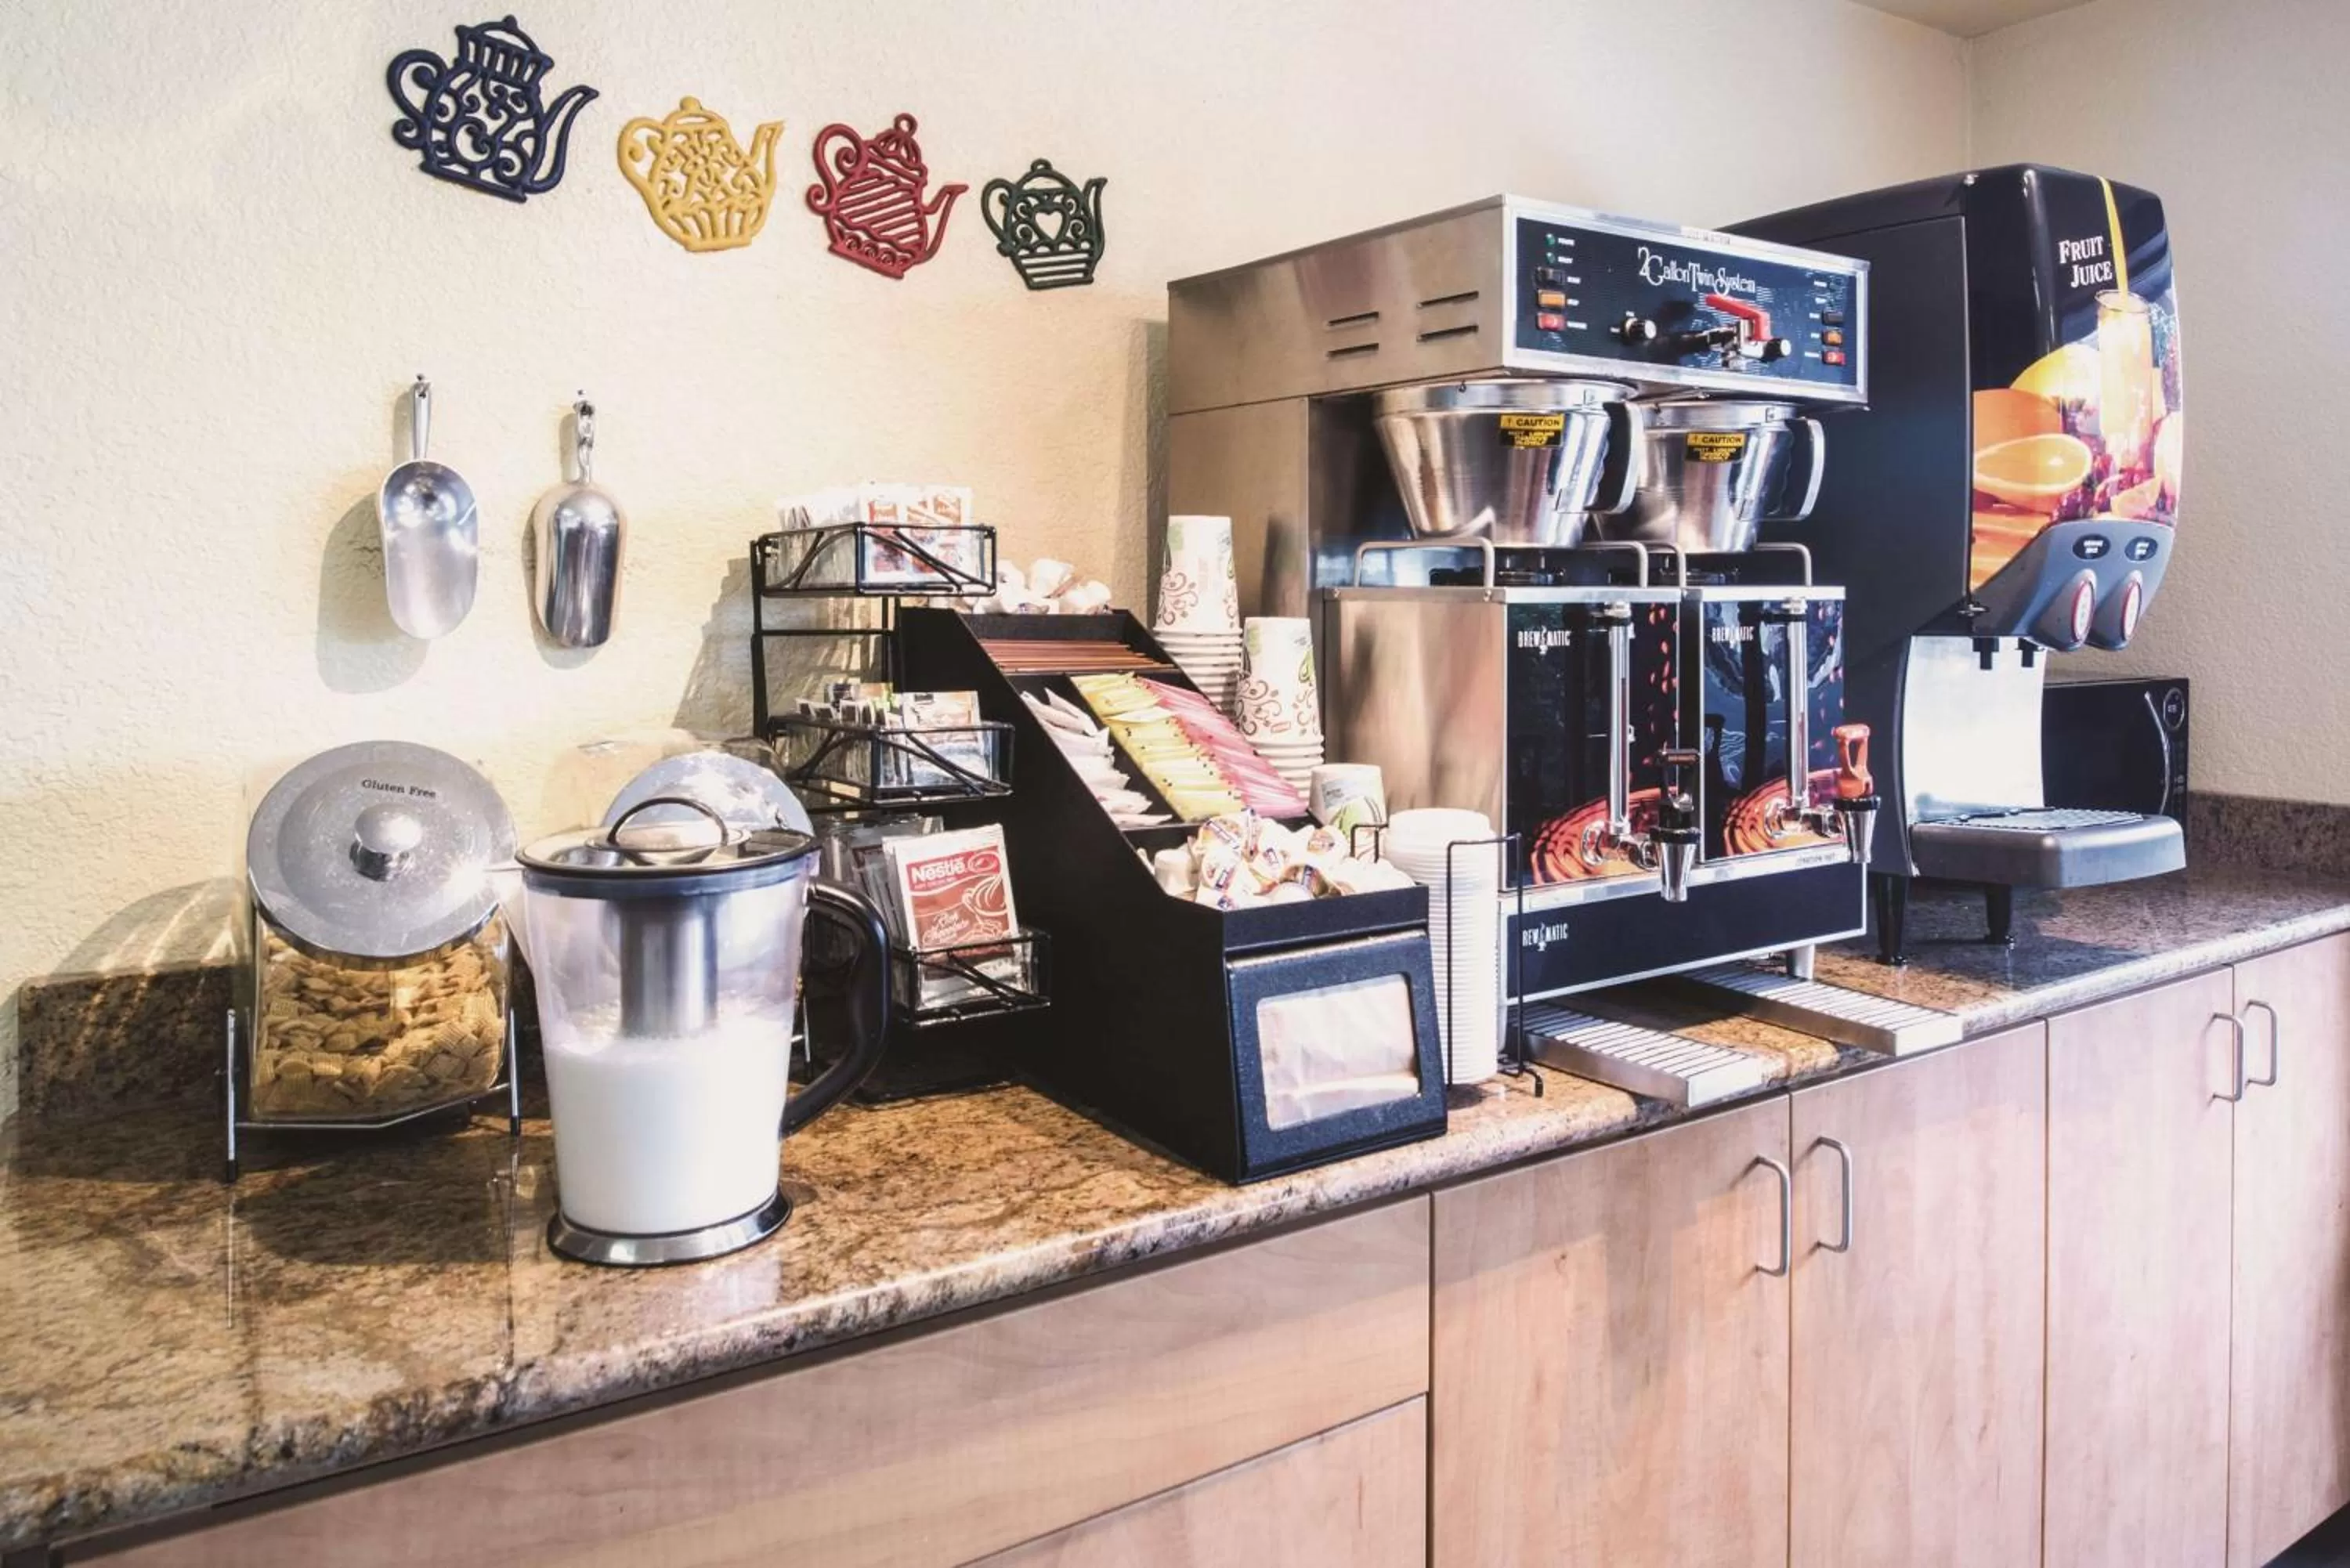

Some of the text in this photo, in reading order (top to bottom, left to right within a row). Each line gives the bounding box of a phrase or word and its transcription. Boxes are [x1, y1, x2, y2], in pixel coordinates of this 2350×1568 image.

[2058, 235, 2104, 264] FRUIT
[1638, 246, 1755, 296] 2 Gallon Twin System
[2070, 261, 2113, 288] JUICE
[1516, 417, 1560, 427] CAUTION
[1701, 435, 1742, 445] CAUTION
[361, 778, 436, 798] Gluten Free
